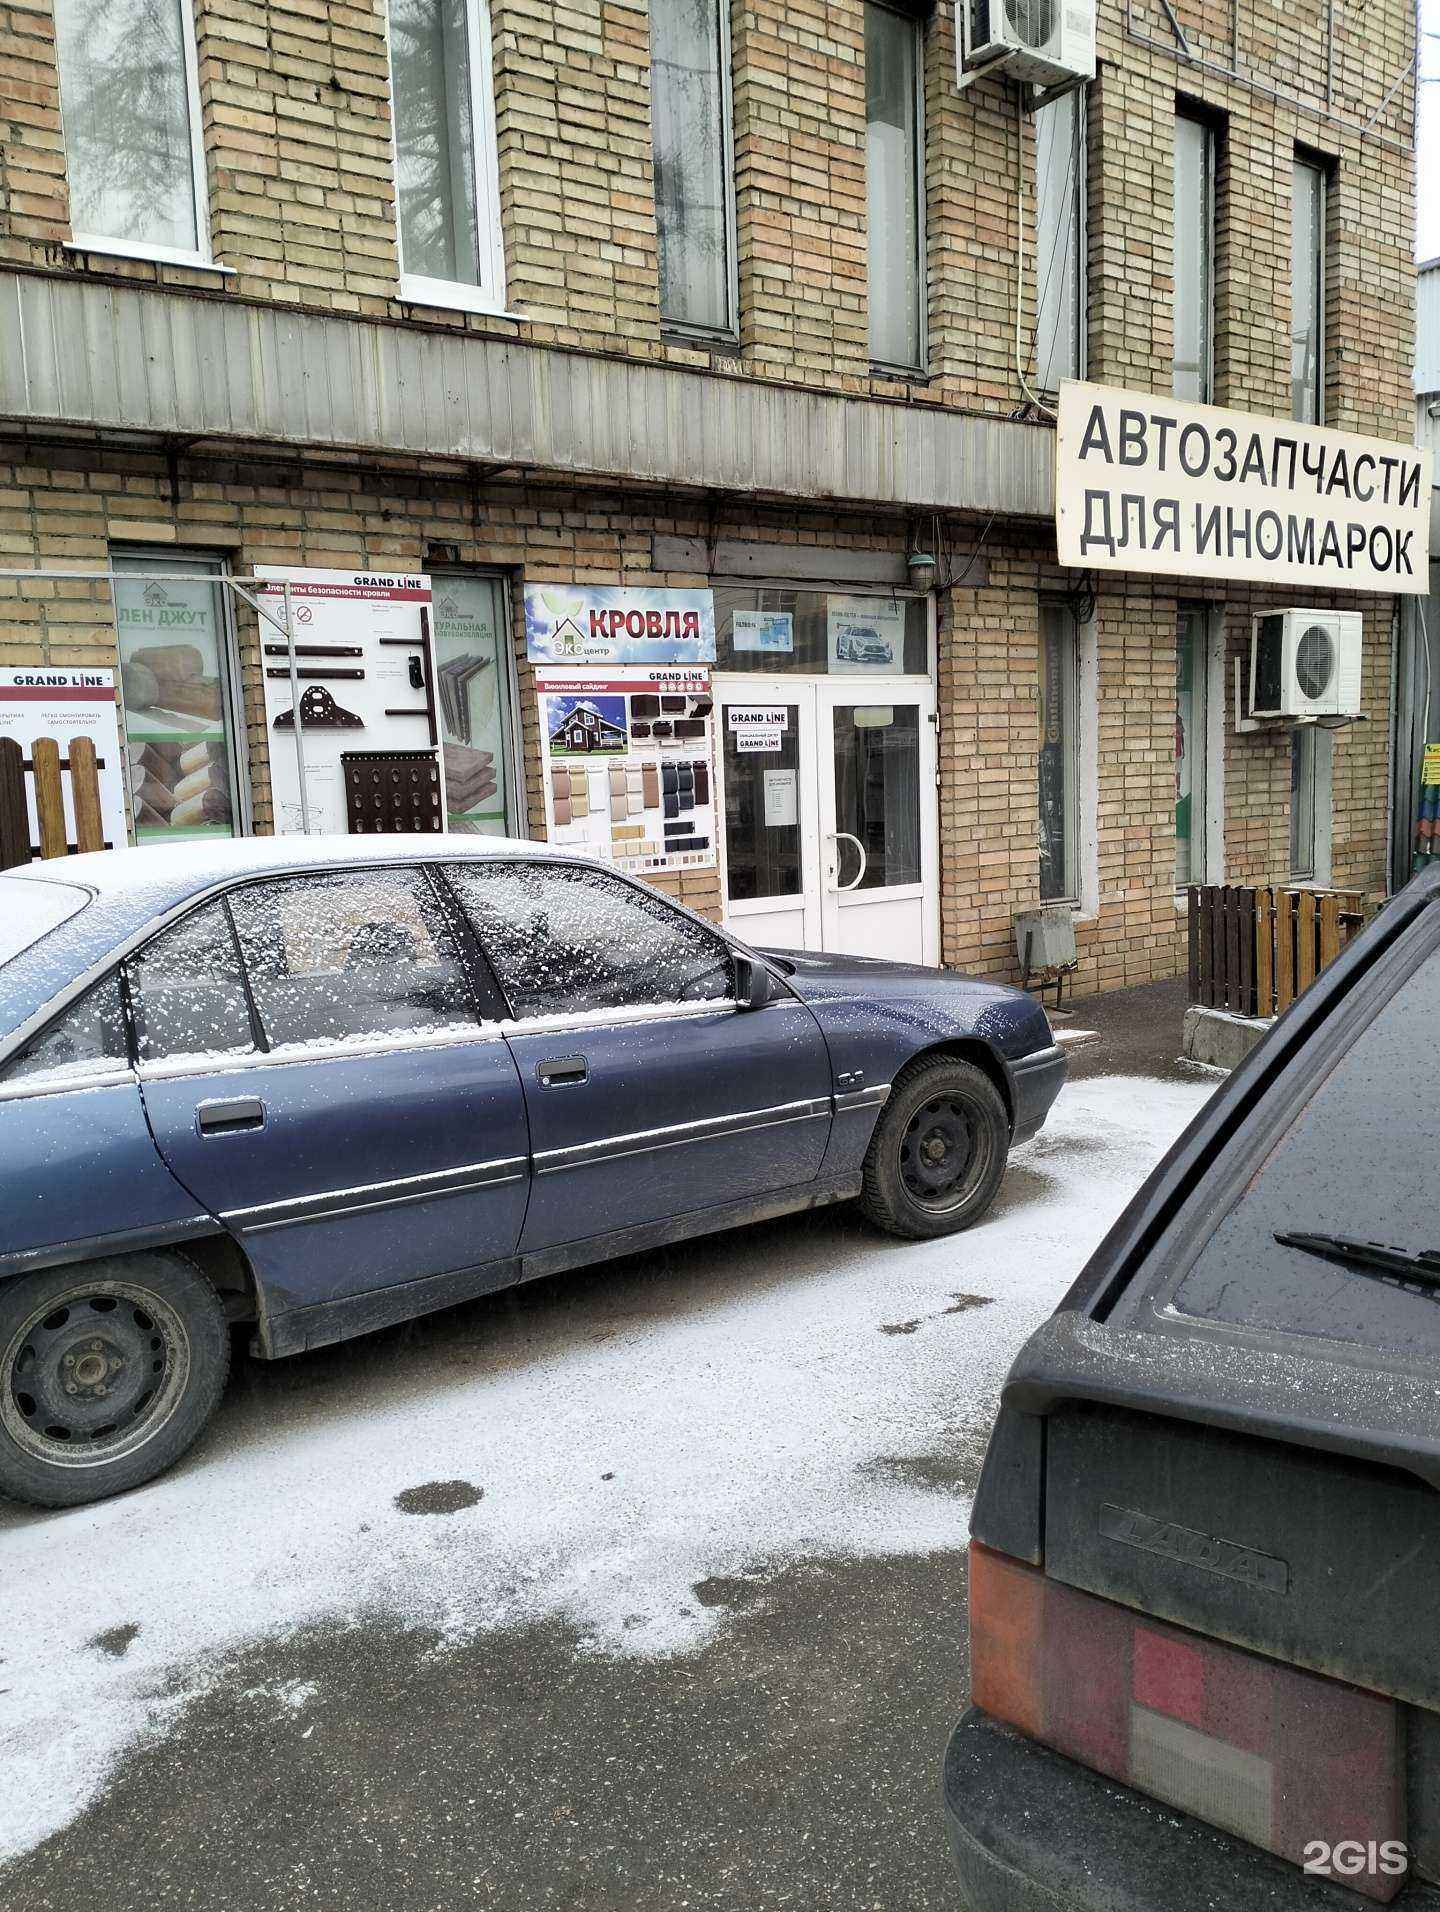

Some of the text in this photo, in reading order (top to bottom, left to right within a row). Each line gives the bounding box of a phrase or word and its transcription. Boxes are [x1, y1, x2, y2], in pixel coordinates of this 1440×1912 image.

[1078, 404, 1422, 509] АВТОЗАПЧАСТИ
[1080, 488, 1414, 575] ДЛЯ ИНОМАРОК
[353, 575, 395, 588] GRAND
[118, 608, 207, 626] ЛЕН ДЖУТ
[588, 608, 701, 640] КРОВЛЯ
[13, 675, 68, 686] GRAND
[648, 671, 682, 681] GRAND
[730, 713, 764, 723] GRAND
[739, 740, 764, 748] GRAND
[1126, 1519, 1266, 1583] LADA
